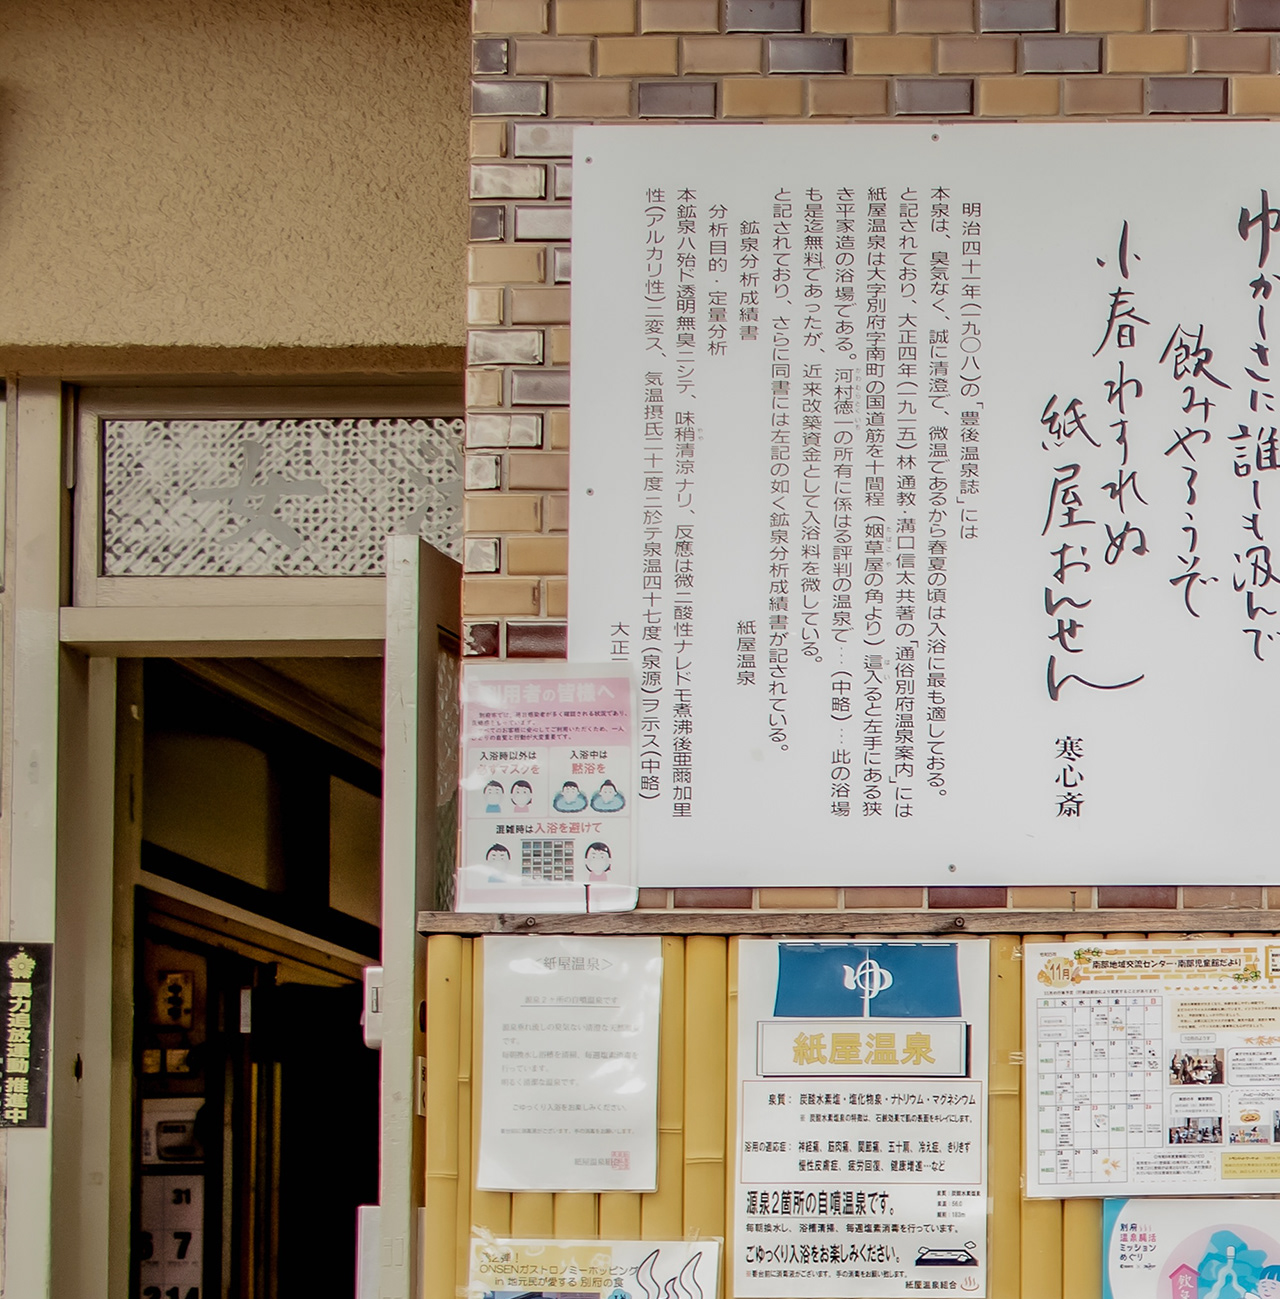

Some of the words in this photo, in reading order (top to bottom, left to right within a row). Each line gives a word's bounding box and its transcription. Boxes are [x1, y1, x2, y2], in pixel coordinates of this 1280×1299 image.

[707, 204, 728, 356] 分析目的・定量分析
[739, 220, 760, 340] 鉱泉分析成績書
[610, 621, 630, 662] 大正
[737, 620, 756, 685] 紙屋温泉
[570, 750, 608, 760] 入浴中は
[1055, 736, 1085, 817] 寒心斎
[842, 959, 893, 999] ゆ
[793, 1031, 936, 1065] 紙屋温泉
[173, 1231, 192, 1260] 7
[1120, 1223, 1137, 1232] 別府
[1120, 1244, 1157, 1252] ミッション
[1120, 1253, 1143, 1262] めぐり
